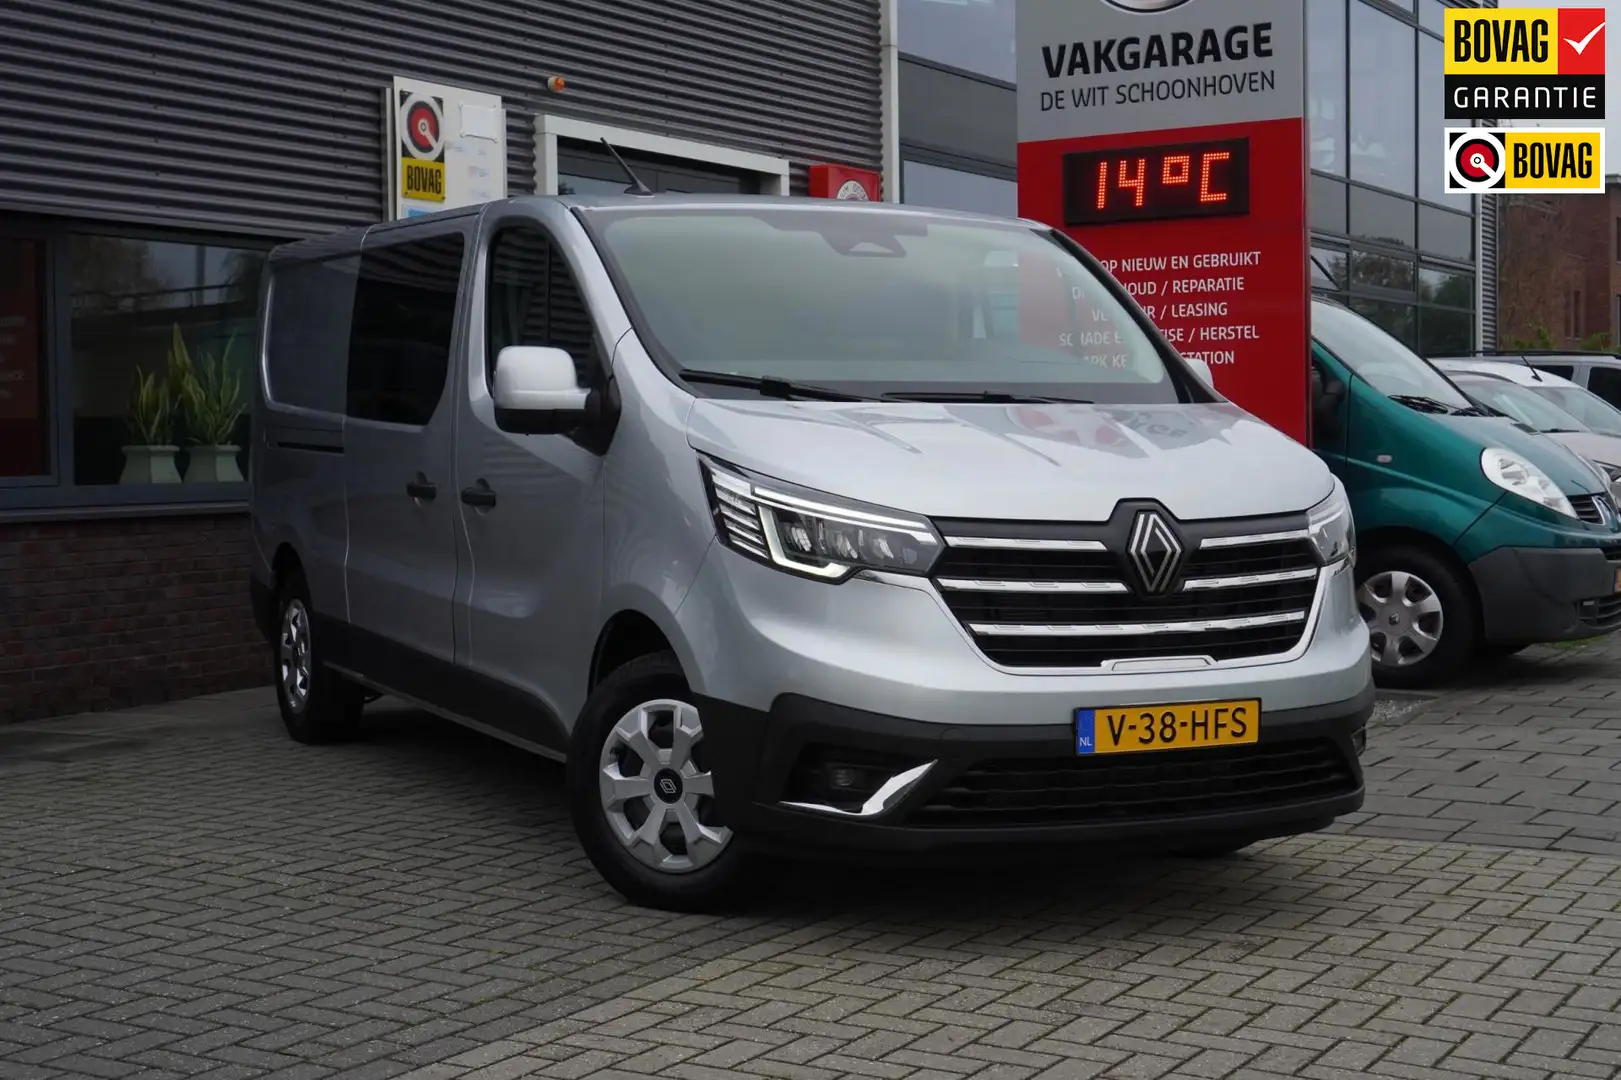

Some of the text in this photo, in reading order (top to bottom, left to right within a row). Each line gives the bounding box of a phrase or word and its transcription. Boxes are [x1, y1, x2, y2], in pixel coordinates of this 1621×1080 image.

[1042, 22, 1273, 78] VAKGARAGE
[1041, 70, 1275, 111] DE WIT SCHOONHOVEN
[406, 165, 442, 194] BOVAG
[1122, 257, 1167, 272] NIEUW
[1171, 255, 1189, 269] EN
[1193, 251, 1262, 269] GEBRUIKT
[1172, 277, 1245, 294] REPARATIE
[1171, 302, 1228, 318] LEASING
[1200, 325, 1260, 341] HERSTEL
[1106, 706, 1247, 746] V-38-HFS
[1079, 736, 1093, 747] NL
